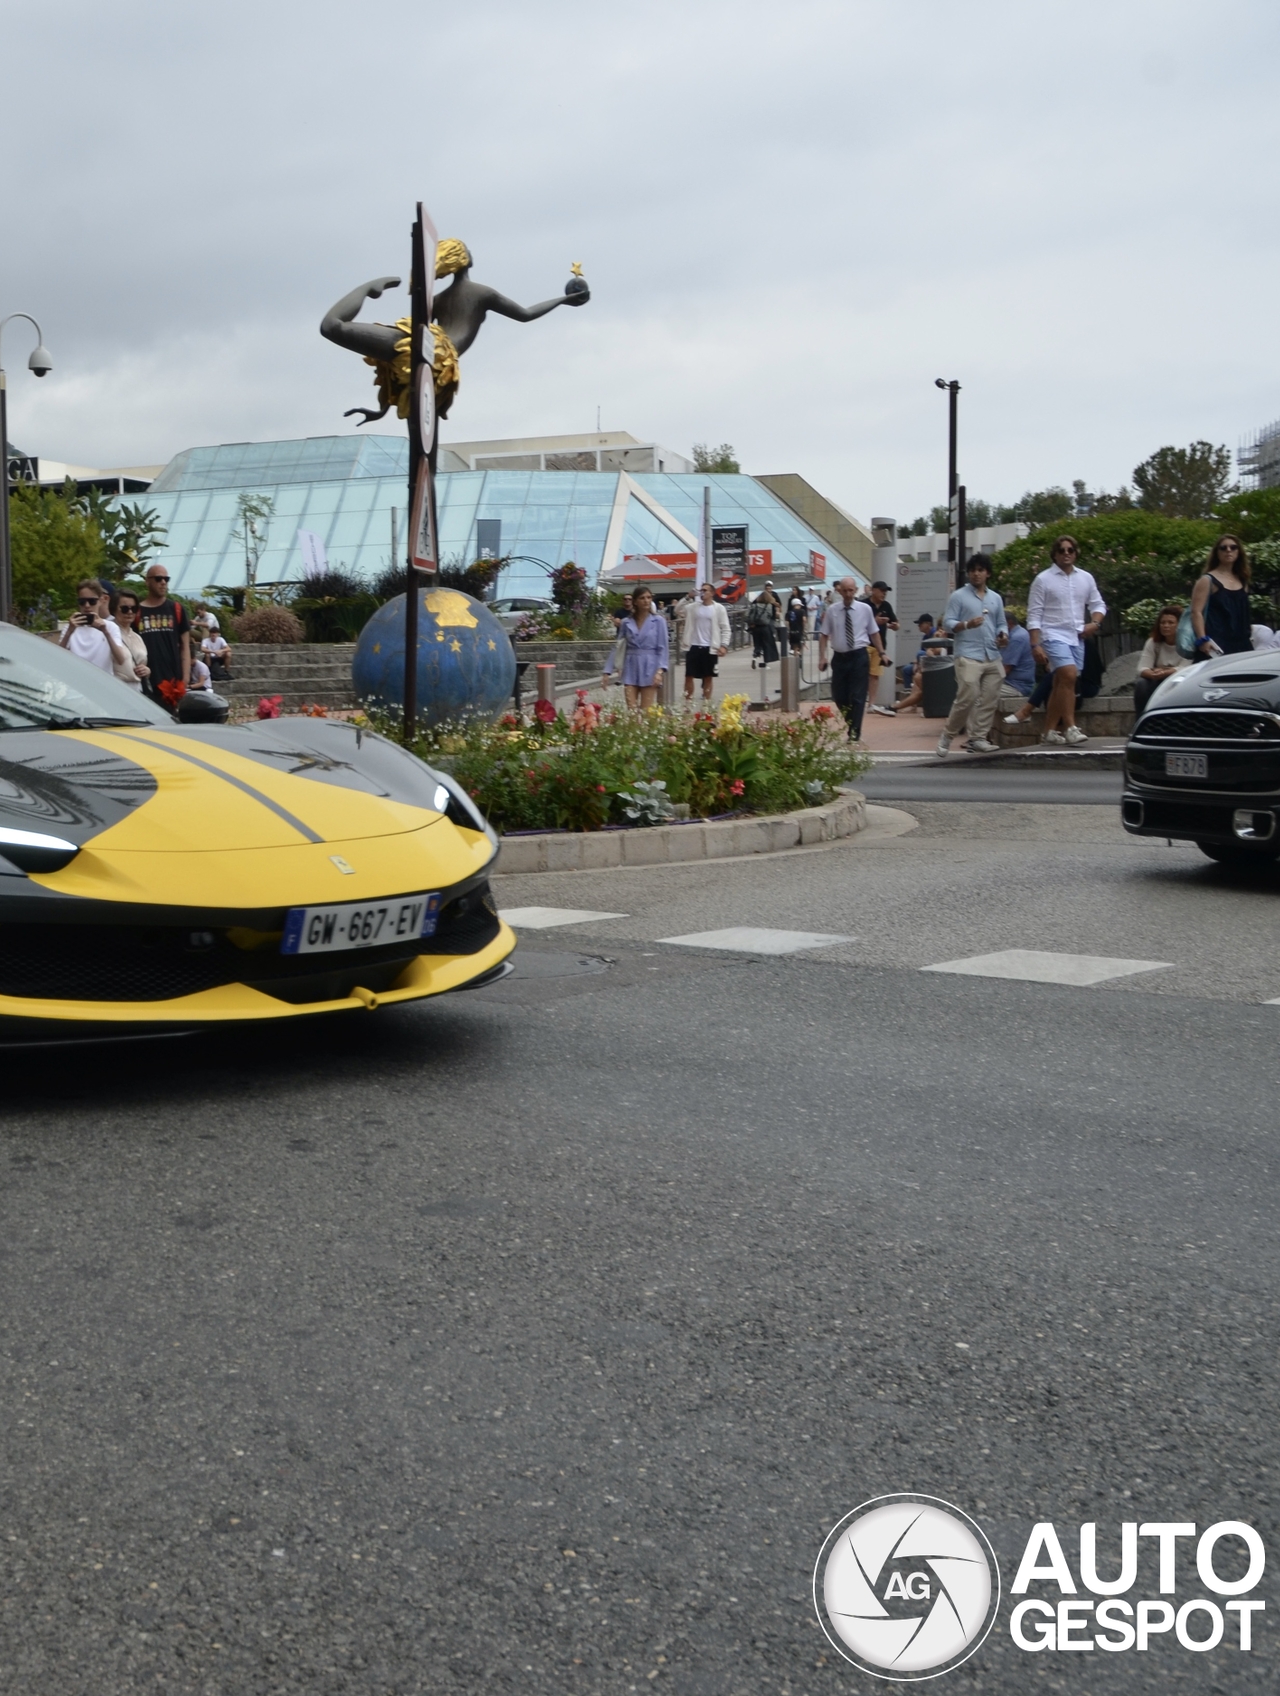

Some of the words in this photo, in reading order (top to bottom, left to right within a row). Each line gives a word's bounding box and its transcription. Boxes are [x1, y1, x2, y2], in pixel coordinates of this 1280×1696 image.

[721, 532, 738, 540] TOP
[286, 934, 297, 947] F
[422, 918, 437, 934] 06
